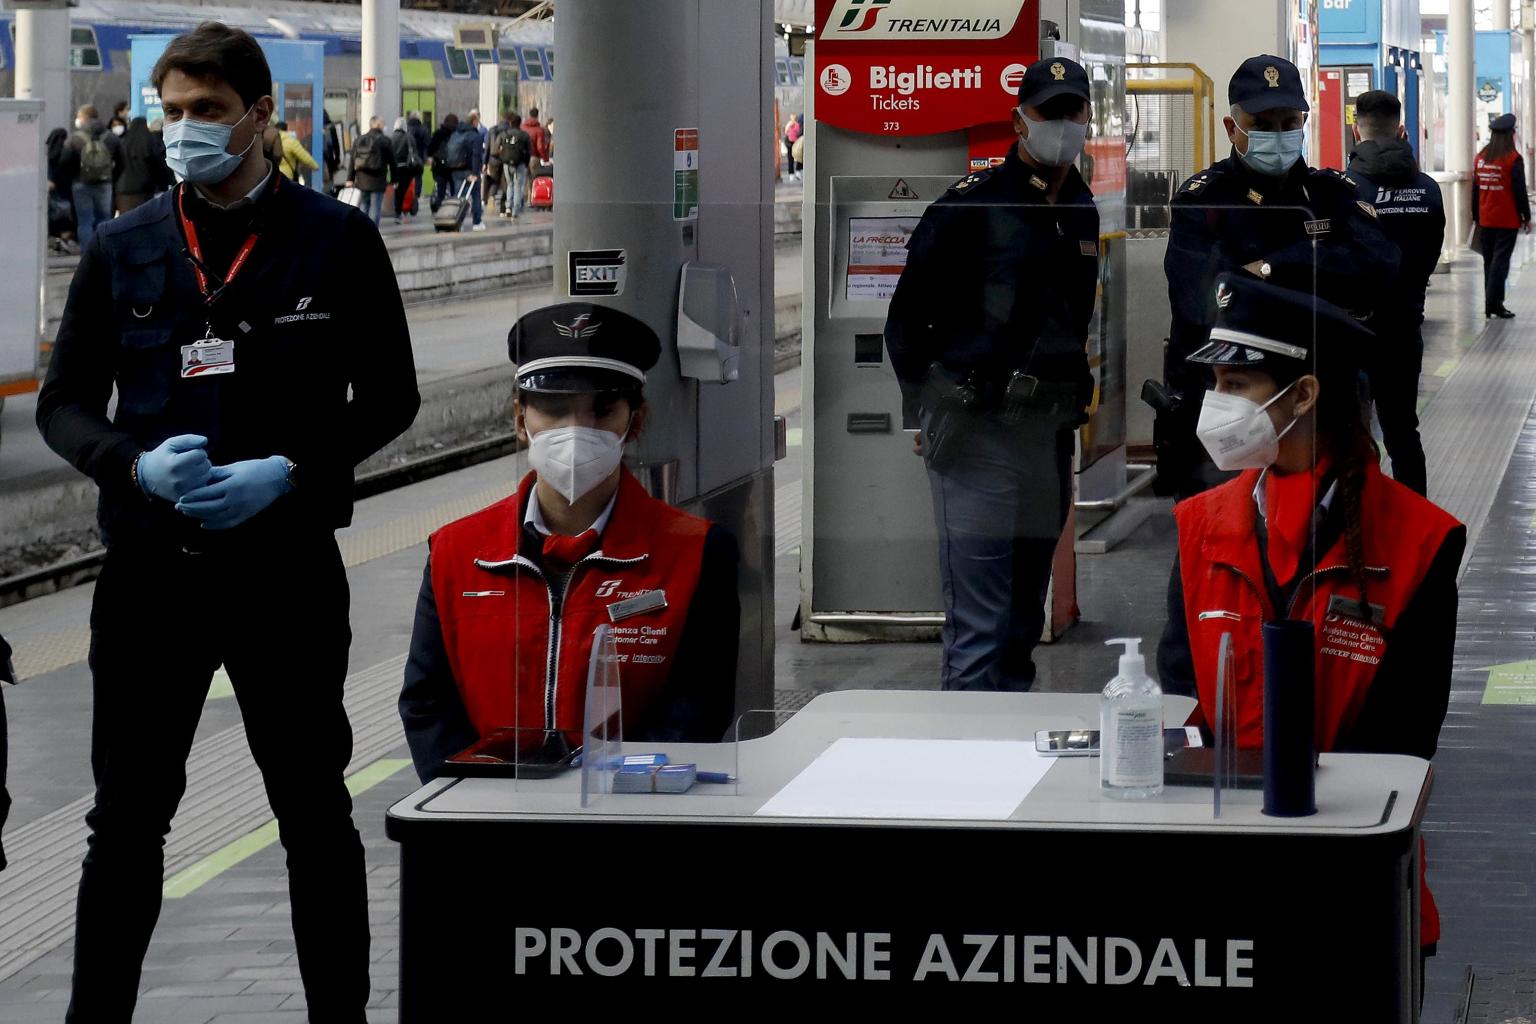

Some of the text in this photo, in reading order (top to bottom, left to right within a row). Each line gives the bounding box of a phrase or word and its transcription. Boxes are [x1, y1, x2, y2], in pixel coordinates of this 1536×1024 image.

[887, 19, 1001, 32] TRENITALIA
[869, 64, 982, 95] Biglietti
[870, 94, 920, 110] Tickets
[883, 122, 900, 131] 373
[853, 236, 905, 244] LA FRECCIA
[577, 266, 619, 281] EXIT
[640, 626, 667, 636] Clienti
[639, 635, 658, 644] Care
[1360, 642, 1376, 652] Care
[514, 927, 1255, 988] PROTEZIONE AZIENDALE
